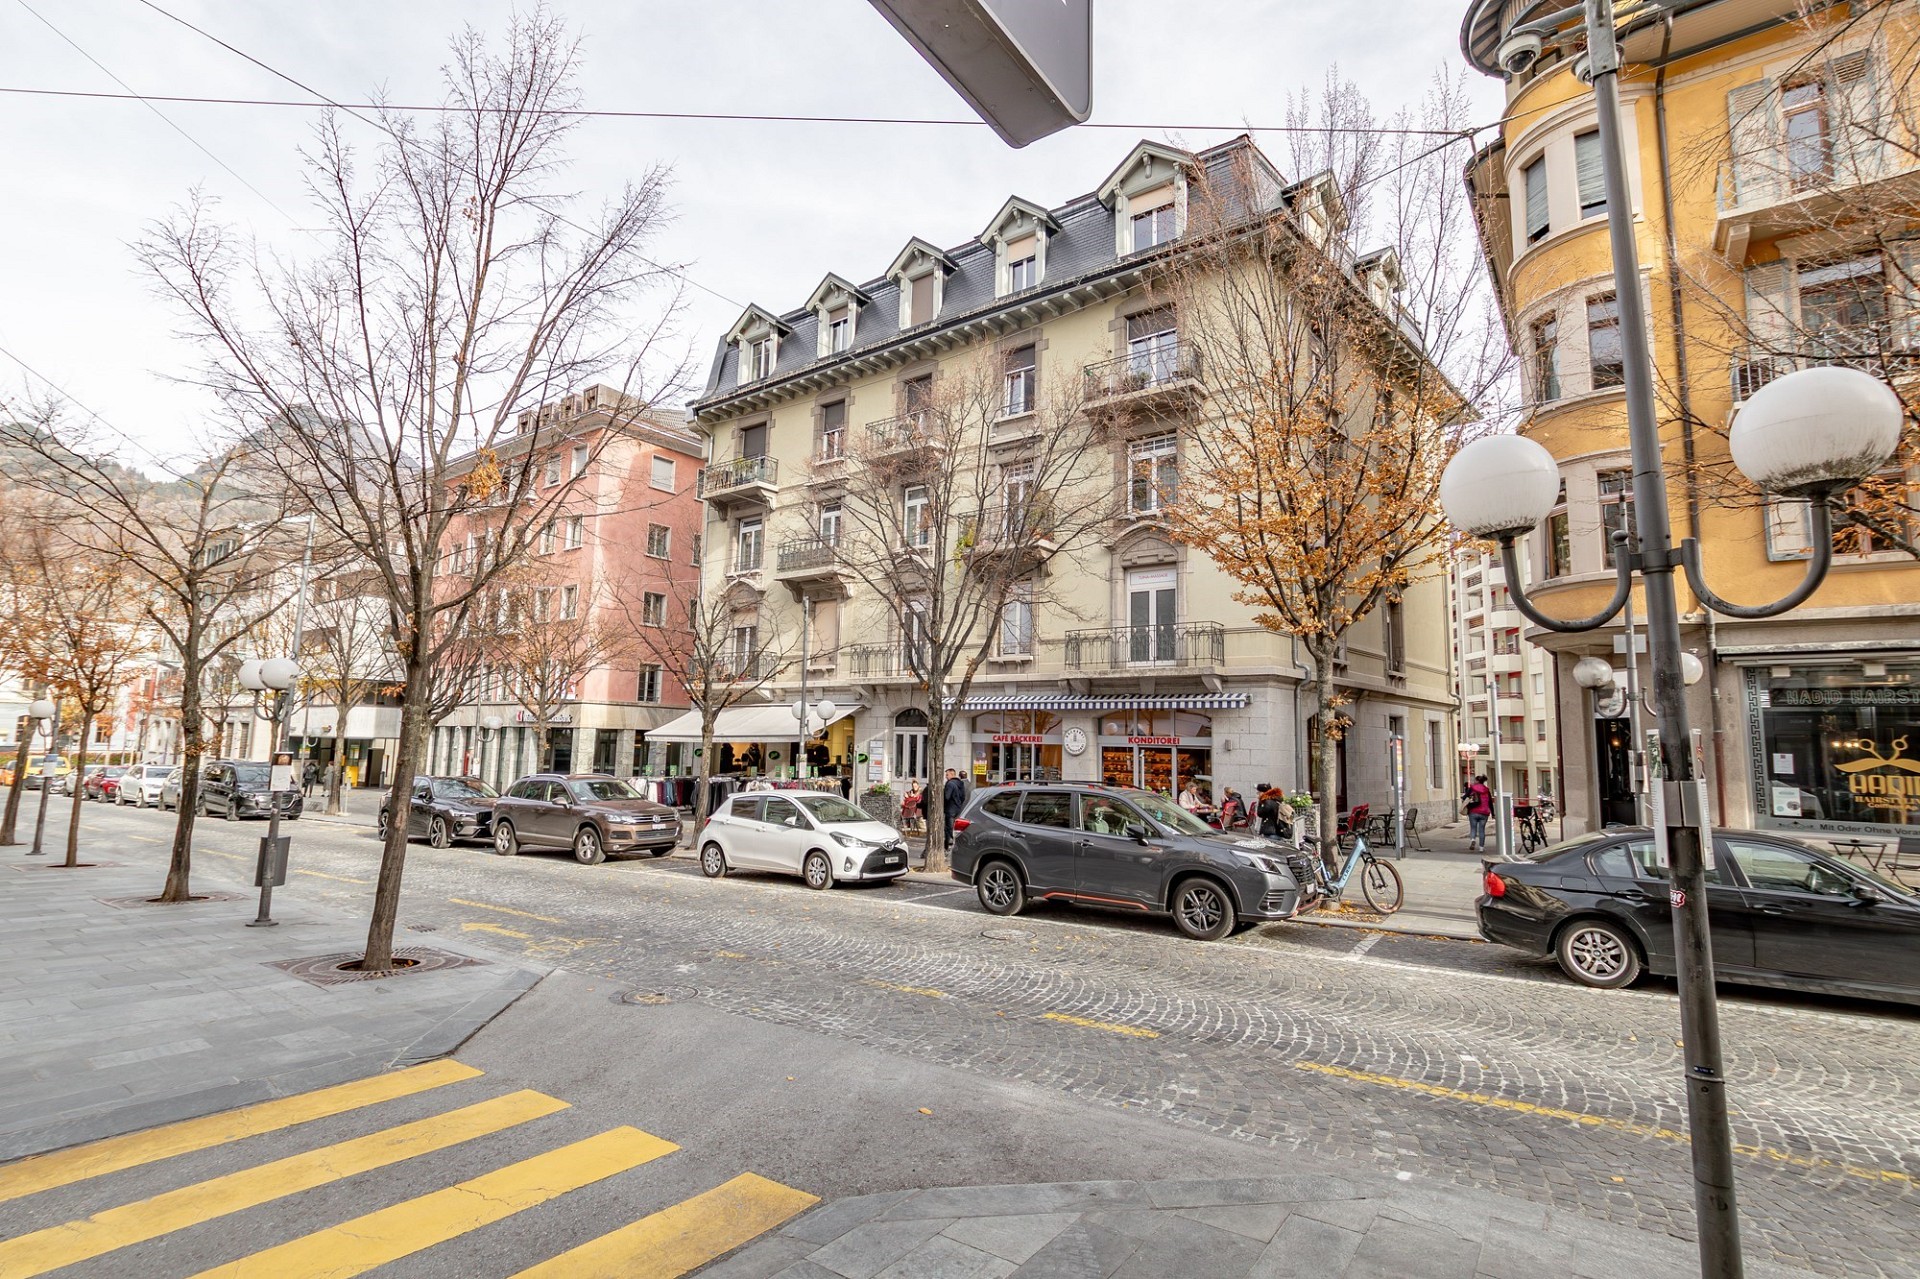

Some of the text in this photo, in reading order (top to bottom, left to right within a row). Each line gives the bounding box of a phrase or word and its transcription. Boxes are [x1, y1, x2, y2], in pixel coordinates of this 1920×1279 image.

[1786, 689, 1842, 705] HADID
[1128, 736, 1180, 745] KONDITOREI
[1820, 823, 1920, 835] Mit Oder Ohne Vora
